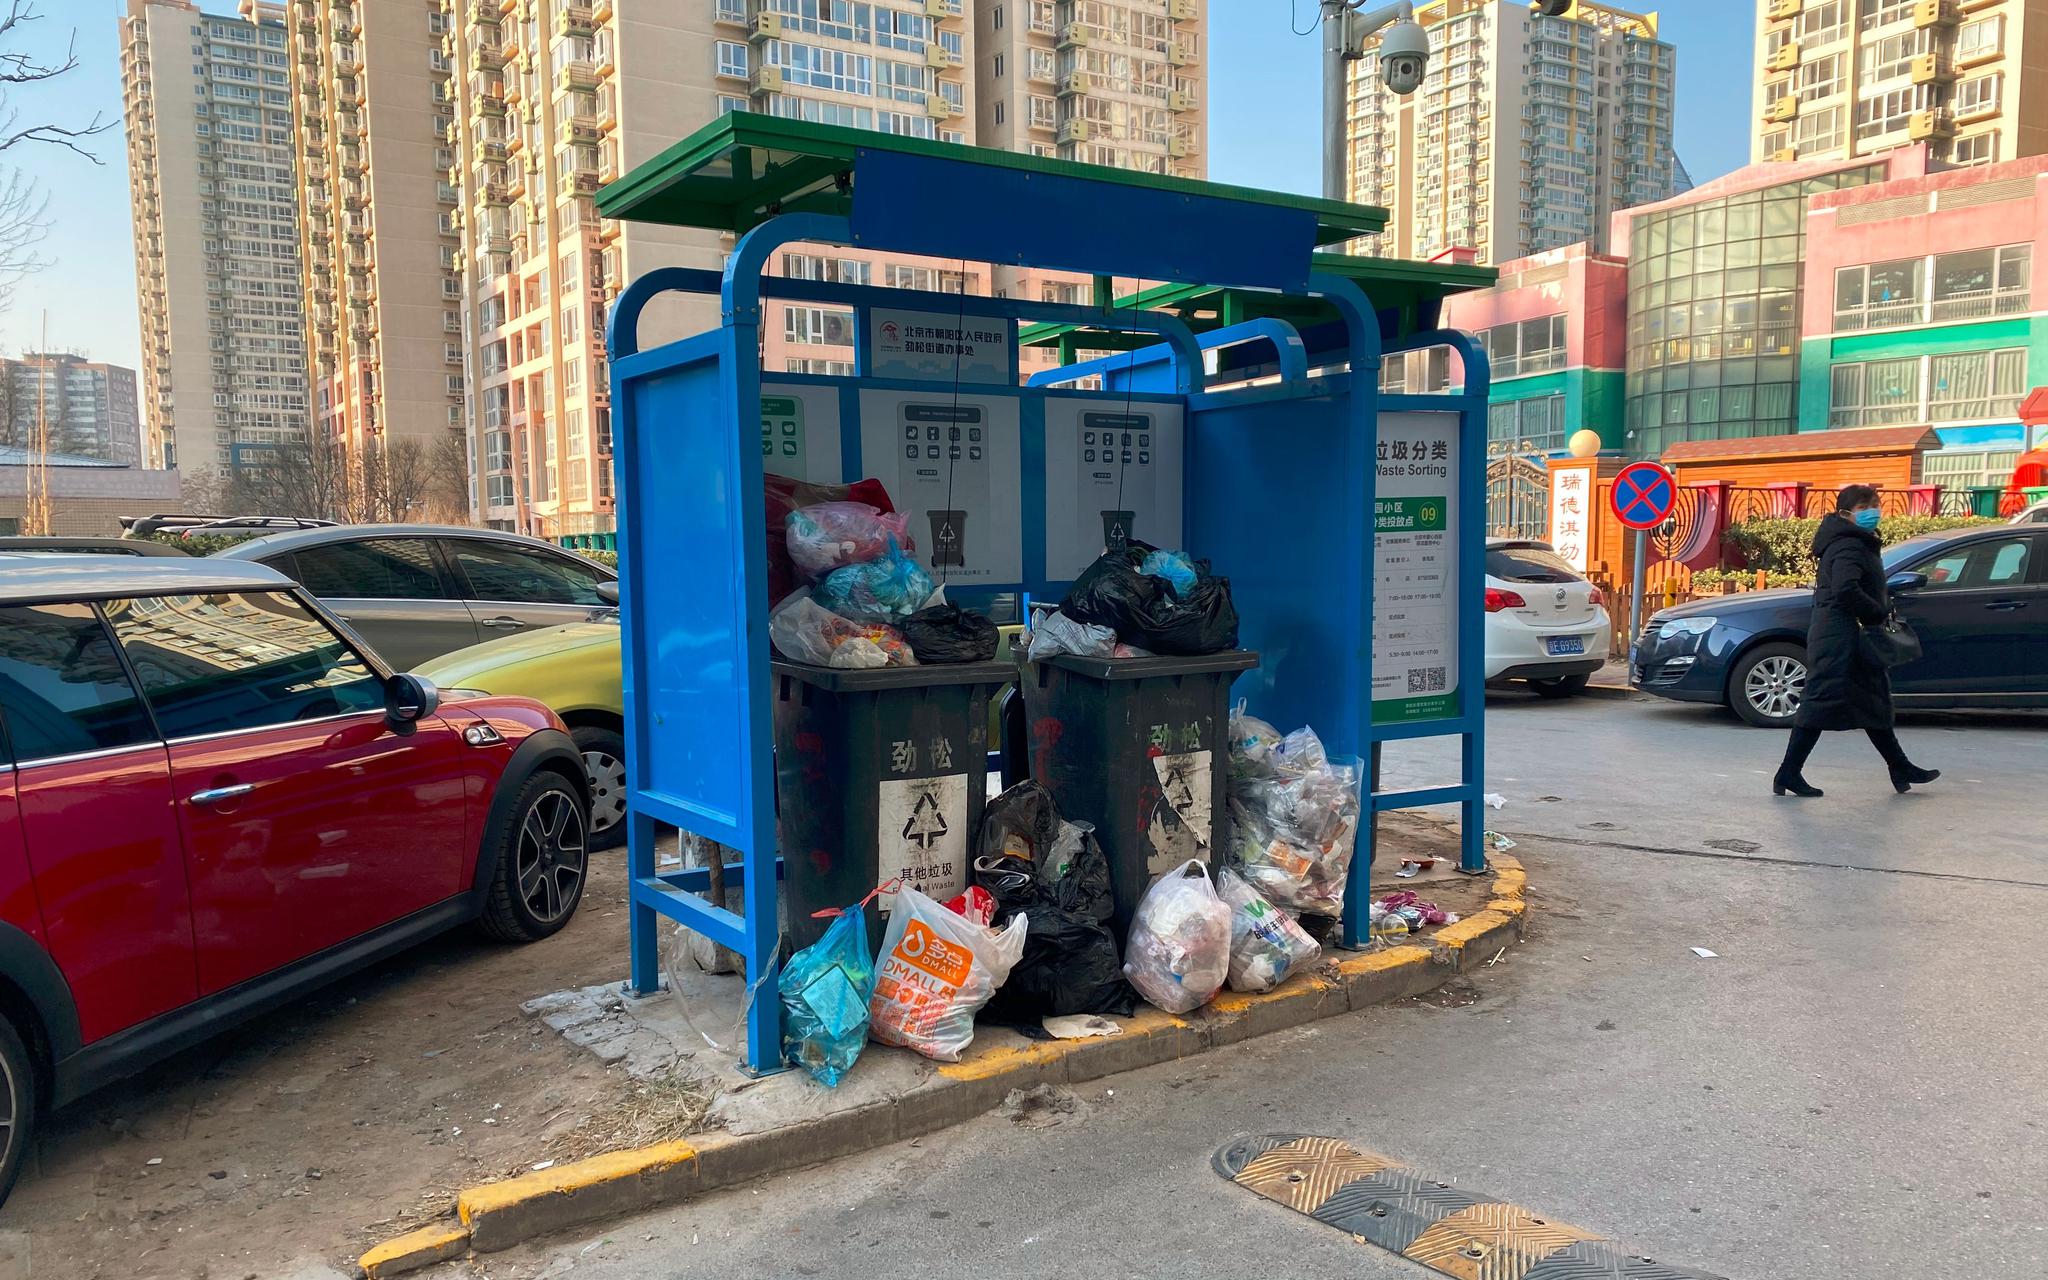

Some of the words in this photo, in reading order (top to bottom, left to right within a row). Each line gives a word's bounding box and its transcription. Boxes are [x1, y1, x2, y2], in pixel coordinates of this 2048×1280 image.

[904, 325, 1003, 343] 北京市朝阳区人民政府
[904, 341, 975, 356] 劲松街道办事处
[1408, 463, 1447, 478] Sorting
[1421, 507, 1436, 521] 09
[891, 737, 953, 773] 劲松
[901, 862, 953, 882] 其他垃圾
[931, 881, 955, 891] Waste
[926, 938, 964, 970] 多点
[883, 958, 936, 994] DMALL
[921, 955, 958, 980] DMALL
